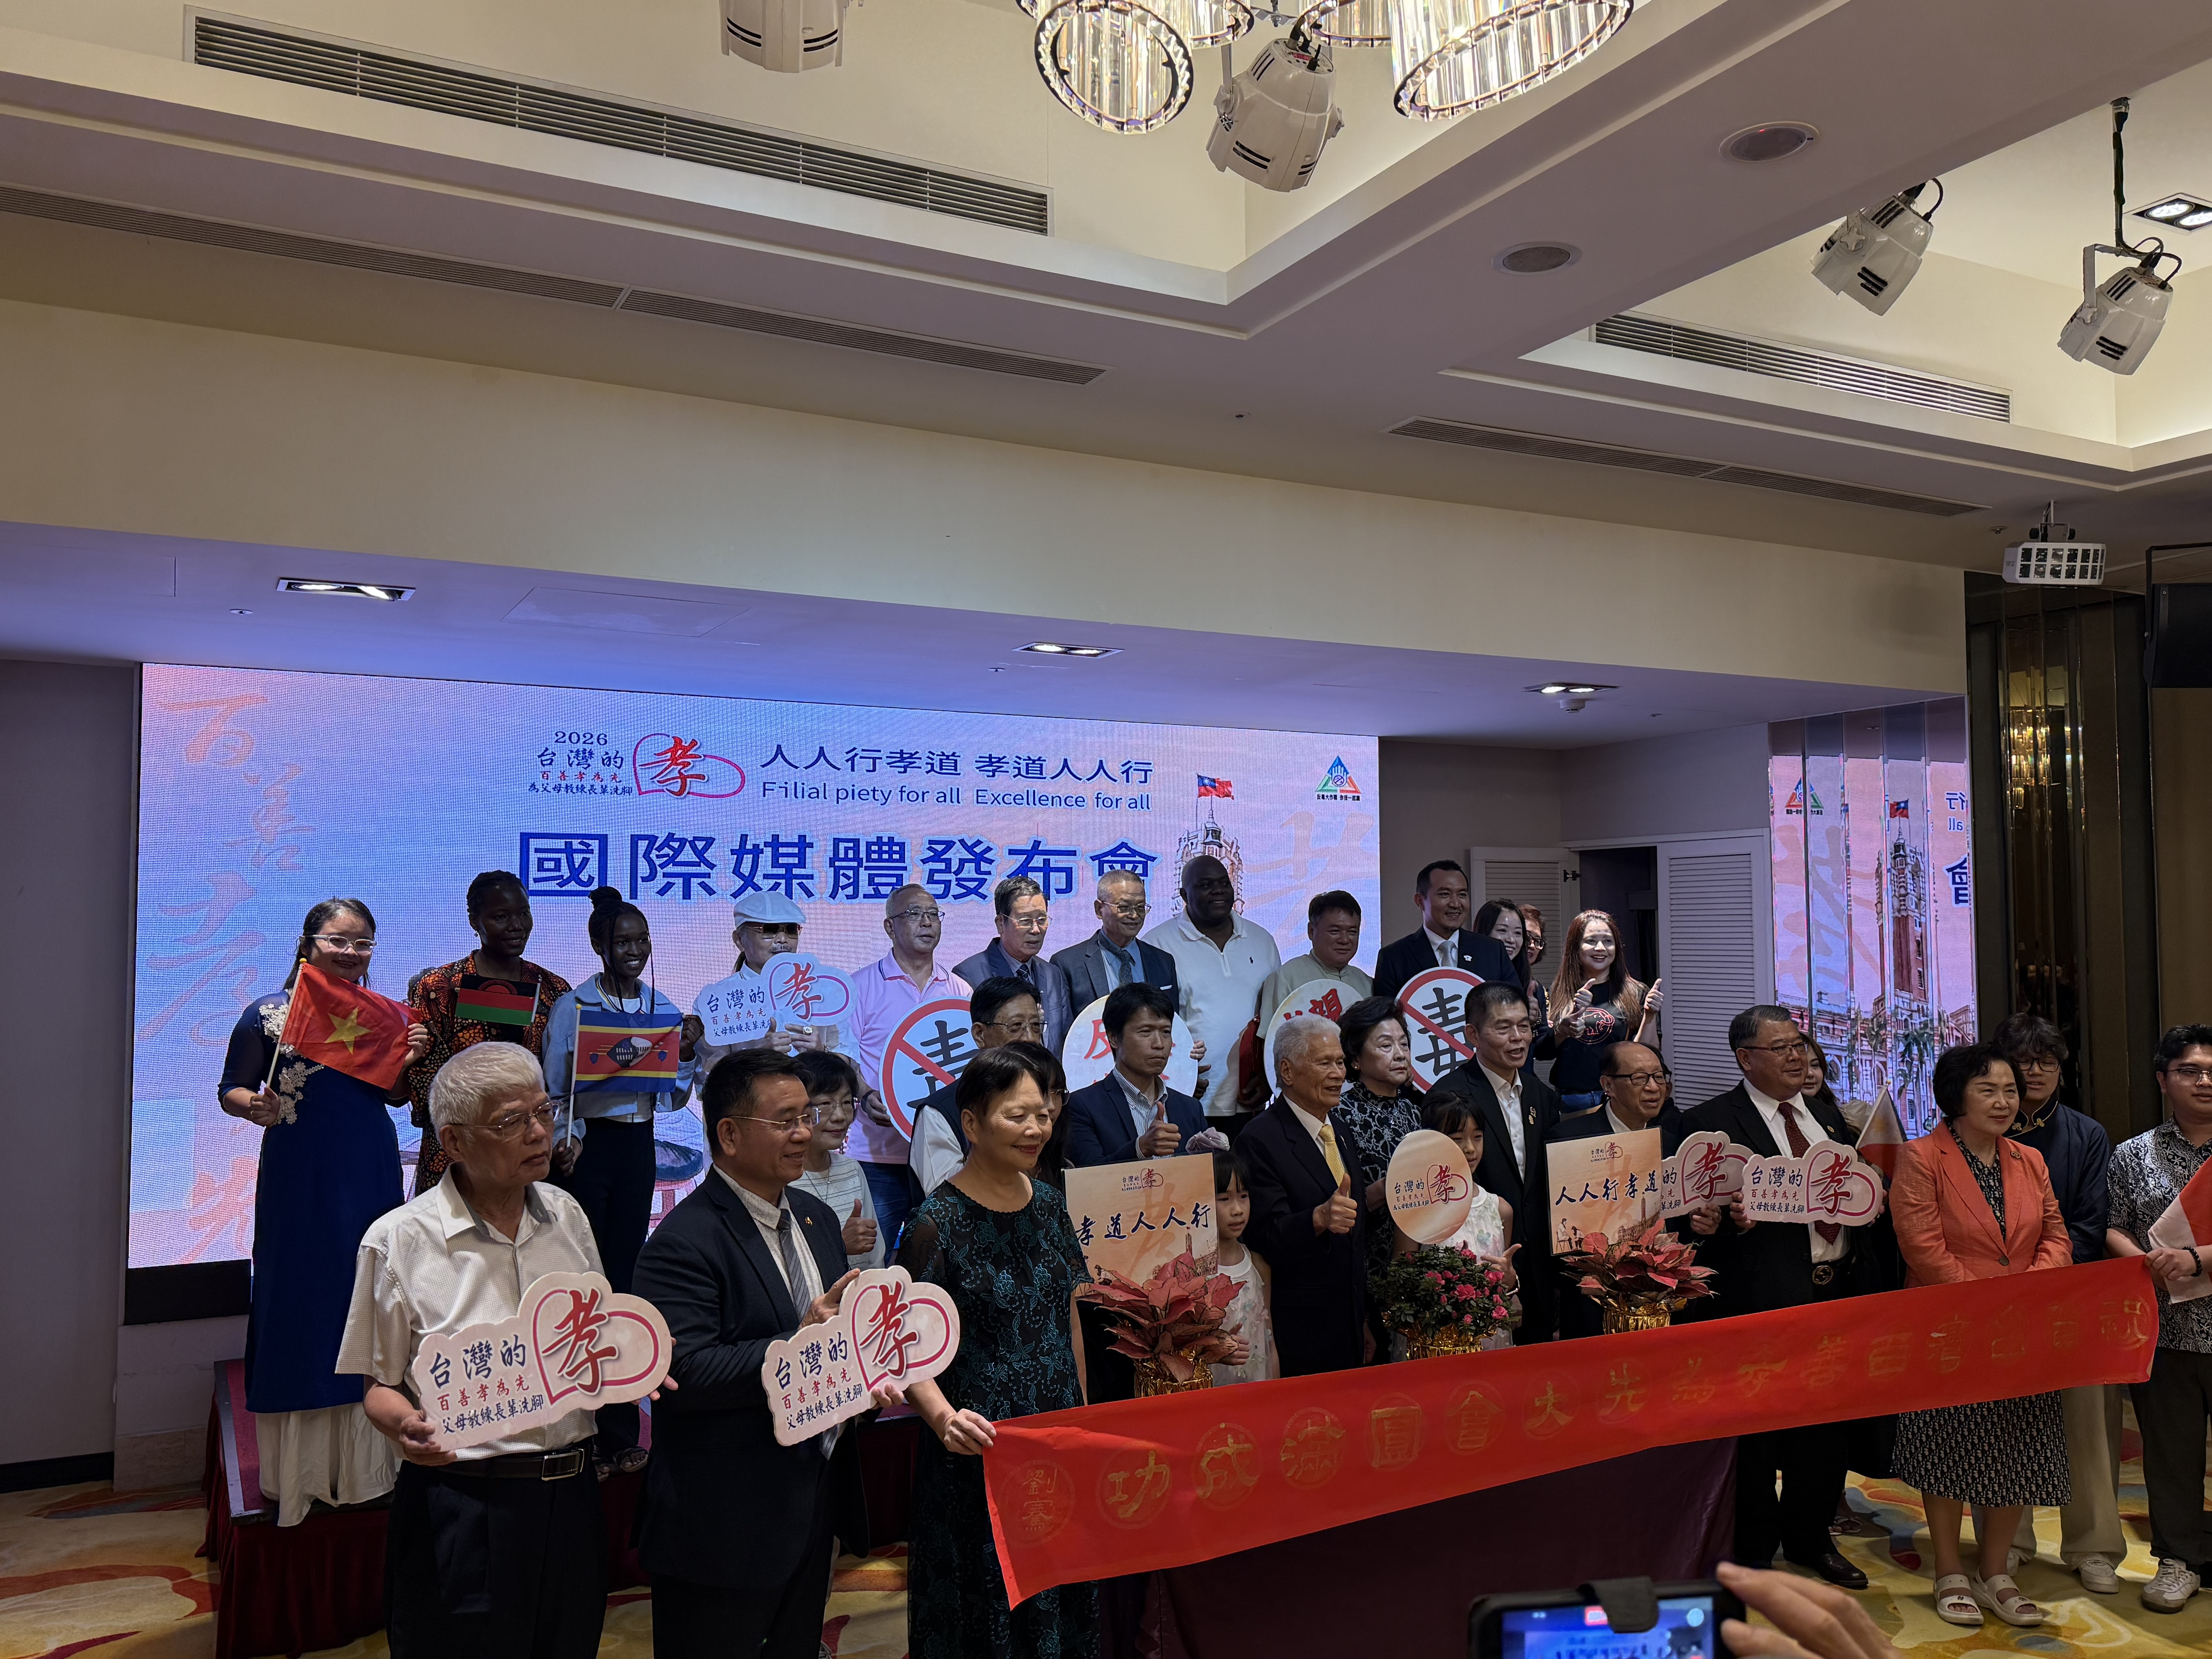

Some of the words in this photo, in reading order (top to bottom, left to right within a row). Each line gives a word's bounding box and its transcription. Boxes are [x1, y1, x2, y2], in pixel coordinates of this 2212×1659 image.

[555, 731, 608, 745] 2026
[538, 747, 624, 770] 台灣的
[639, 736, 705, 796] 孝
[760, 744, 961, 776] 人人行孝道
[975, 754, 1153, 783] 孝道人人行
[762, 781, 827, 800] Filial
[836, 785, 892, 805] piety
[899, 786, 929, 803] for
[935, 787, 961, 804] all
[976, 789, 1085, 807] Excellence
[1094, 792, 1122, 809] for
[1128, 793, 1150, 810] all
[520, 832, 1158, 901] 國際媒體發布會
[707, 986, 765, 1013] 台灣的
[775, 962, 822, 1019] 孝
[711, 1007, 766, 1025] 百善孝為先
[1394, 1178, 1424, 1194] 台灣的
[1429, 1164, 1455, 1203] 孝
[1555, 1170, 1658, 1205] 人人行孝道
[1685, 1142, 1726, 1200] 孝
[1751, 1165, 1803, 1188] 台灣的
[1810, 1152, 1851, 1214] 孝
[1751, 1189, 1799, 1201] 百善孝為先
[1075, 1202, 1211, 1247] 孝道人人行
[429, 1334, 527, 1389] 台灣的
[542, 1288, 617, 1394] 孝
[775, 1331, 848, 1390] 台灣的
[860, 1281, 917, 1376] 孝
[437, 1374, 530, 1411] 百善孝為先
[781, 1367, 851, 1410] 百善孝為先
[787, 1383, 863, 1430] 父母教練長輩洗腳
[442, 1394, 544, 1434] 父母教練長輩洗腳
